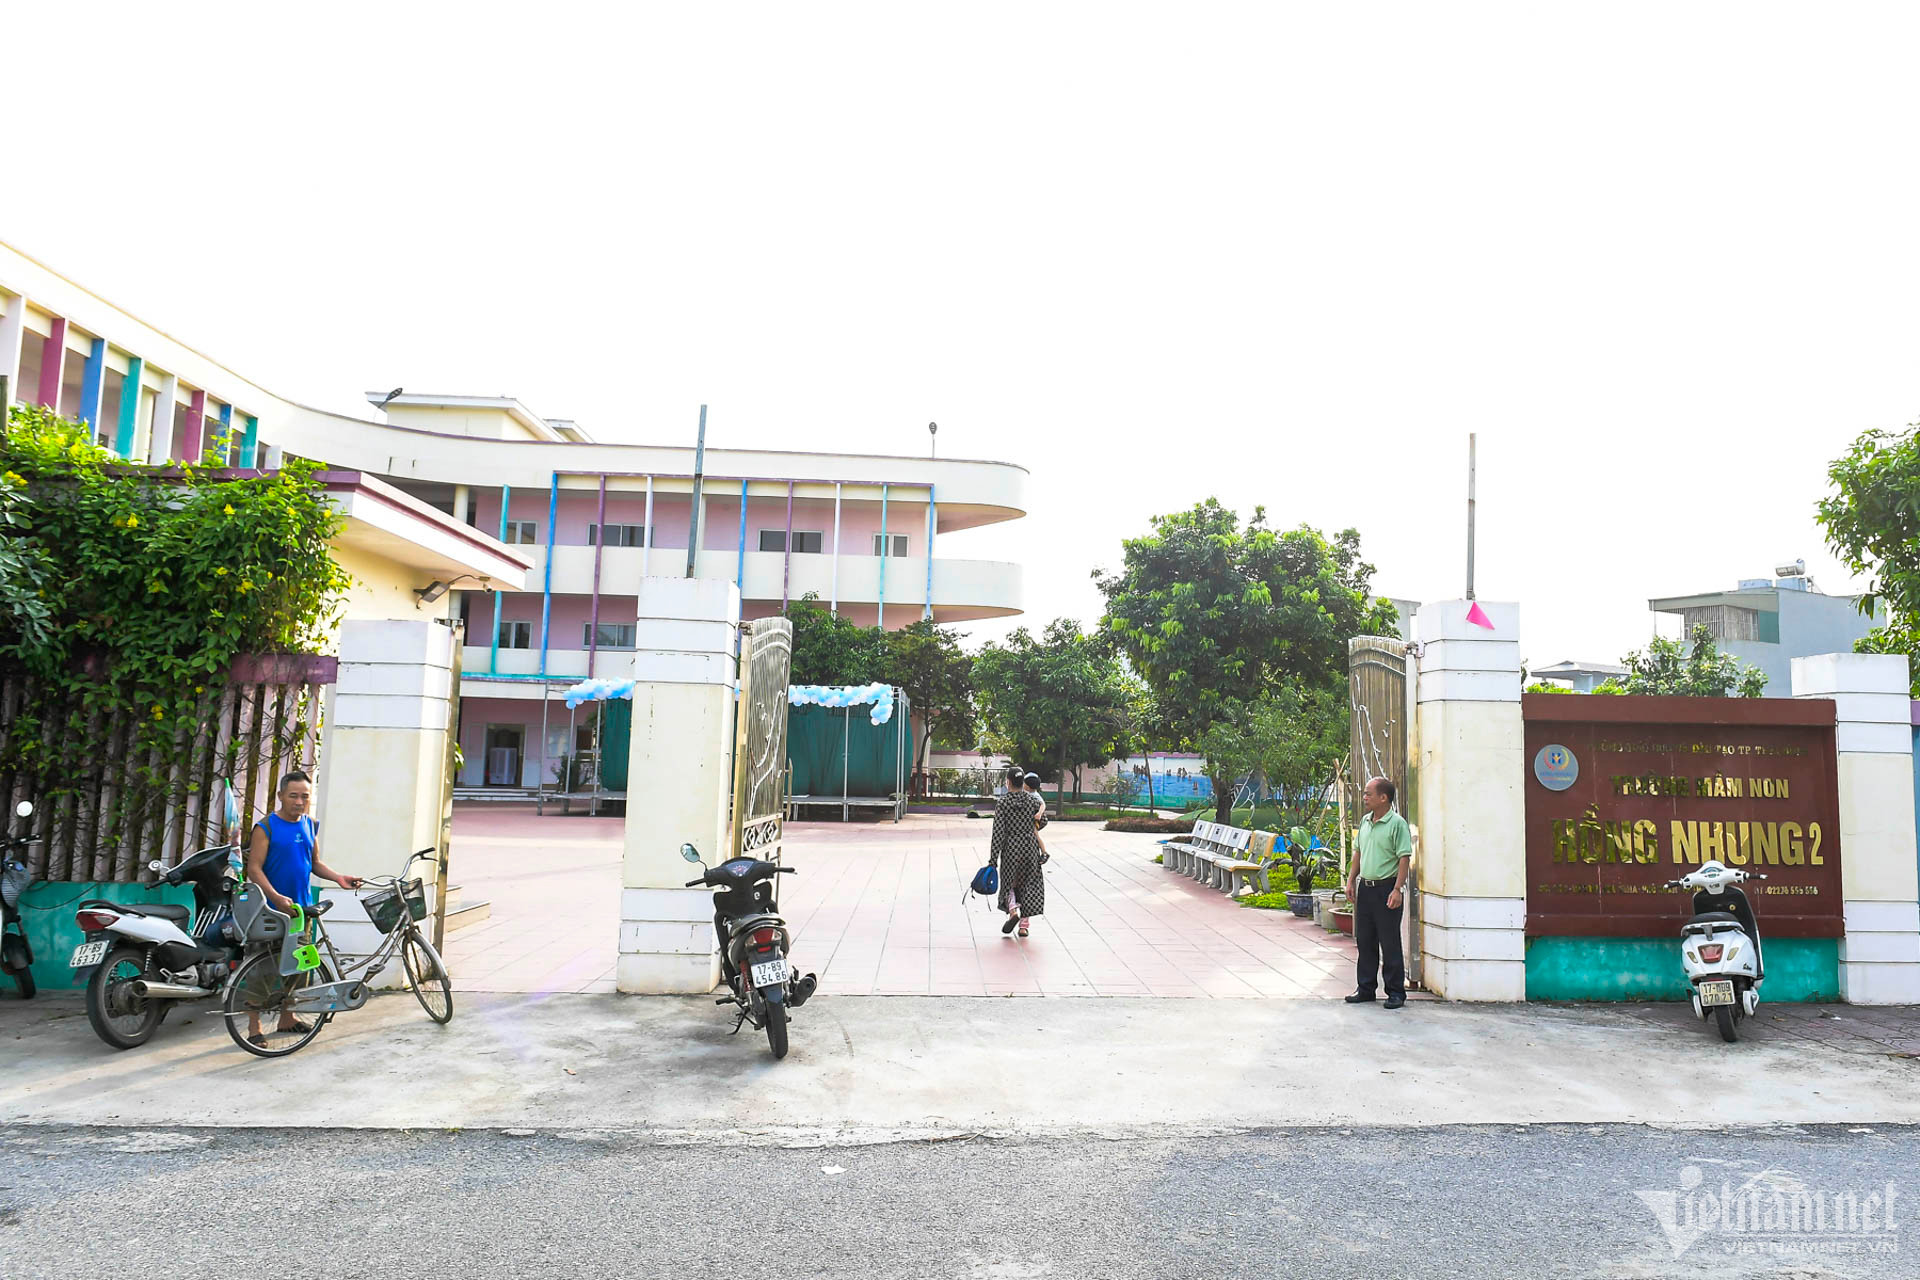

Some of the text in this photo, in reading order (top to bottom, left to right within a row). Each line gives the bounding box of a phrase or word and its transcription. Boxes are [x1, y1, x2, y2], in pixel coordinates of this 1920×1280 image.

[1738, 745, 1751, 755] TP
[1695, 768, 1743, 798] MẦM
[1749, 776, 1789, 799] NON
[1551, 802, 1658, 865] HỒNG
[755, 970, 788, 985] 454.86
